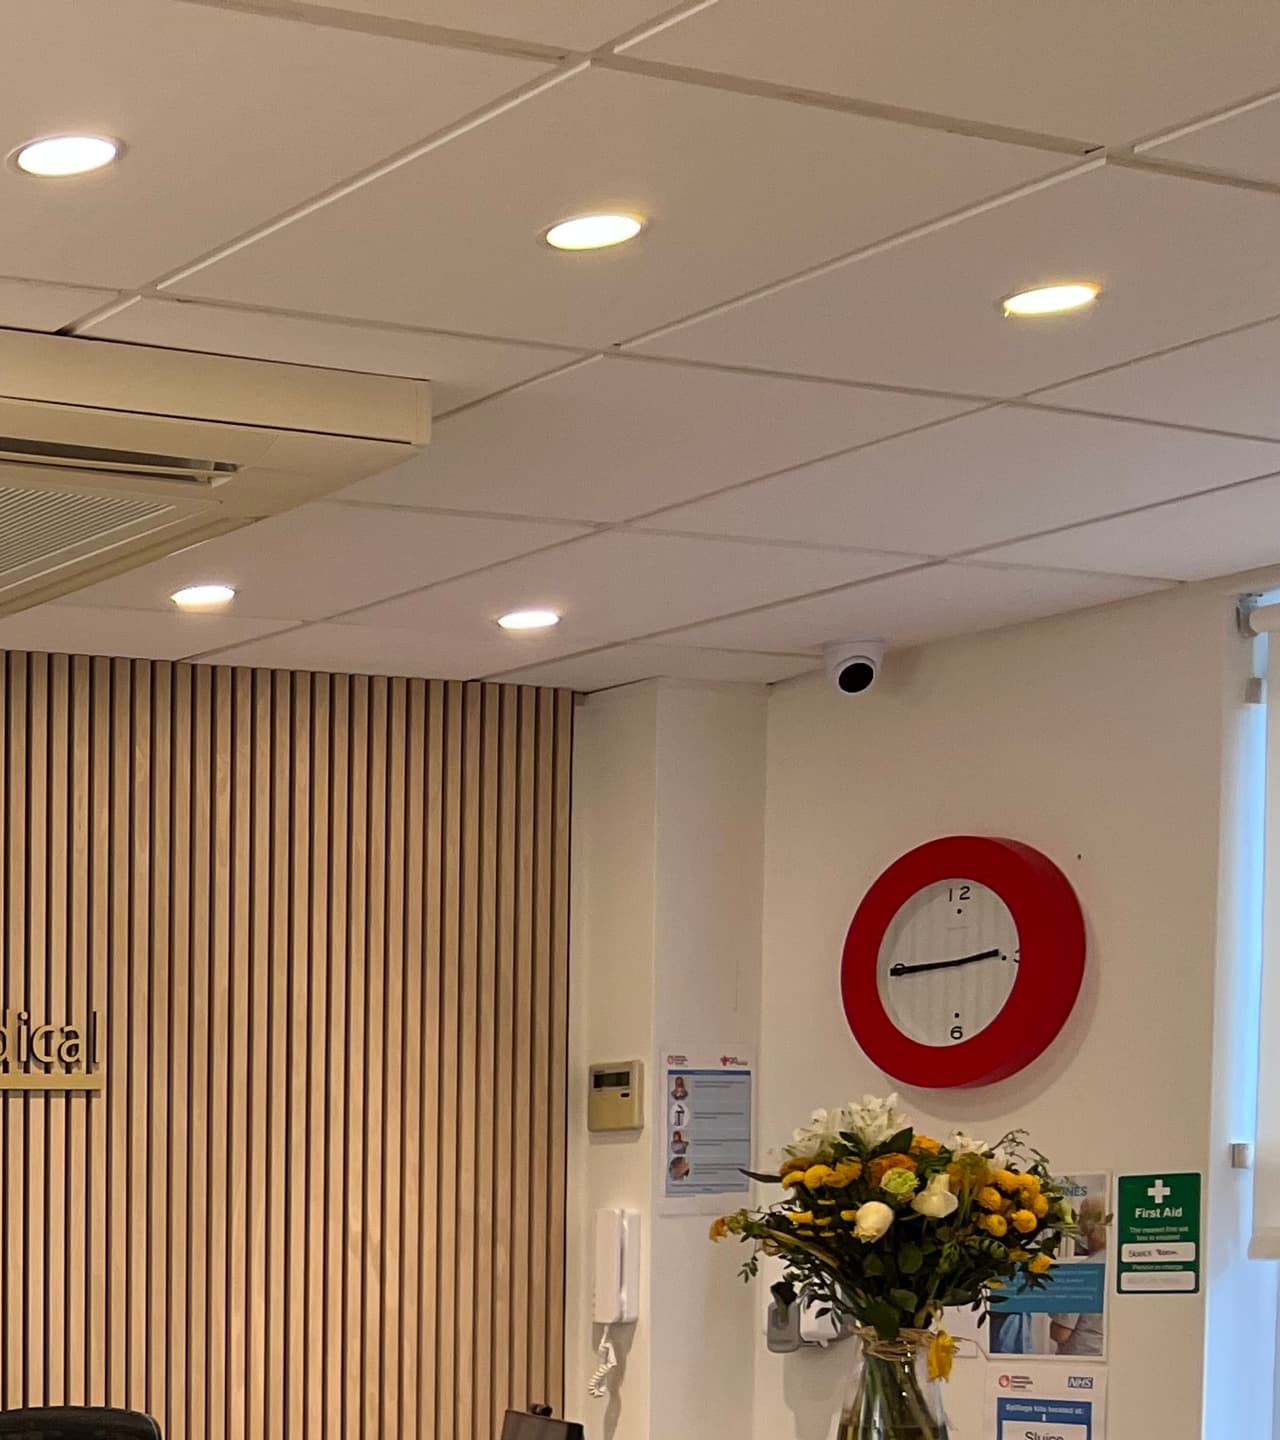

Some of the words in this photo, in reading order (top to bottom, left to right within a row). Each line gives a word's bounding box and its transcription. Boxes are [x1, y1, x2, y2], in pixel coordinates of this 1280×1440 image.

[949, 886, 970, 902] 12
[950, 1026, 963, 1040] 6
[1135, 1208, 1160, 1218] First
[1162, 1207, 1183, 1217] Aid
[1068, 1377, 1093, 1388] NHS
